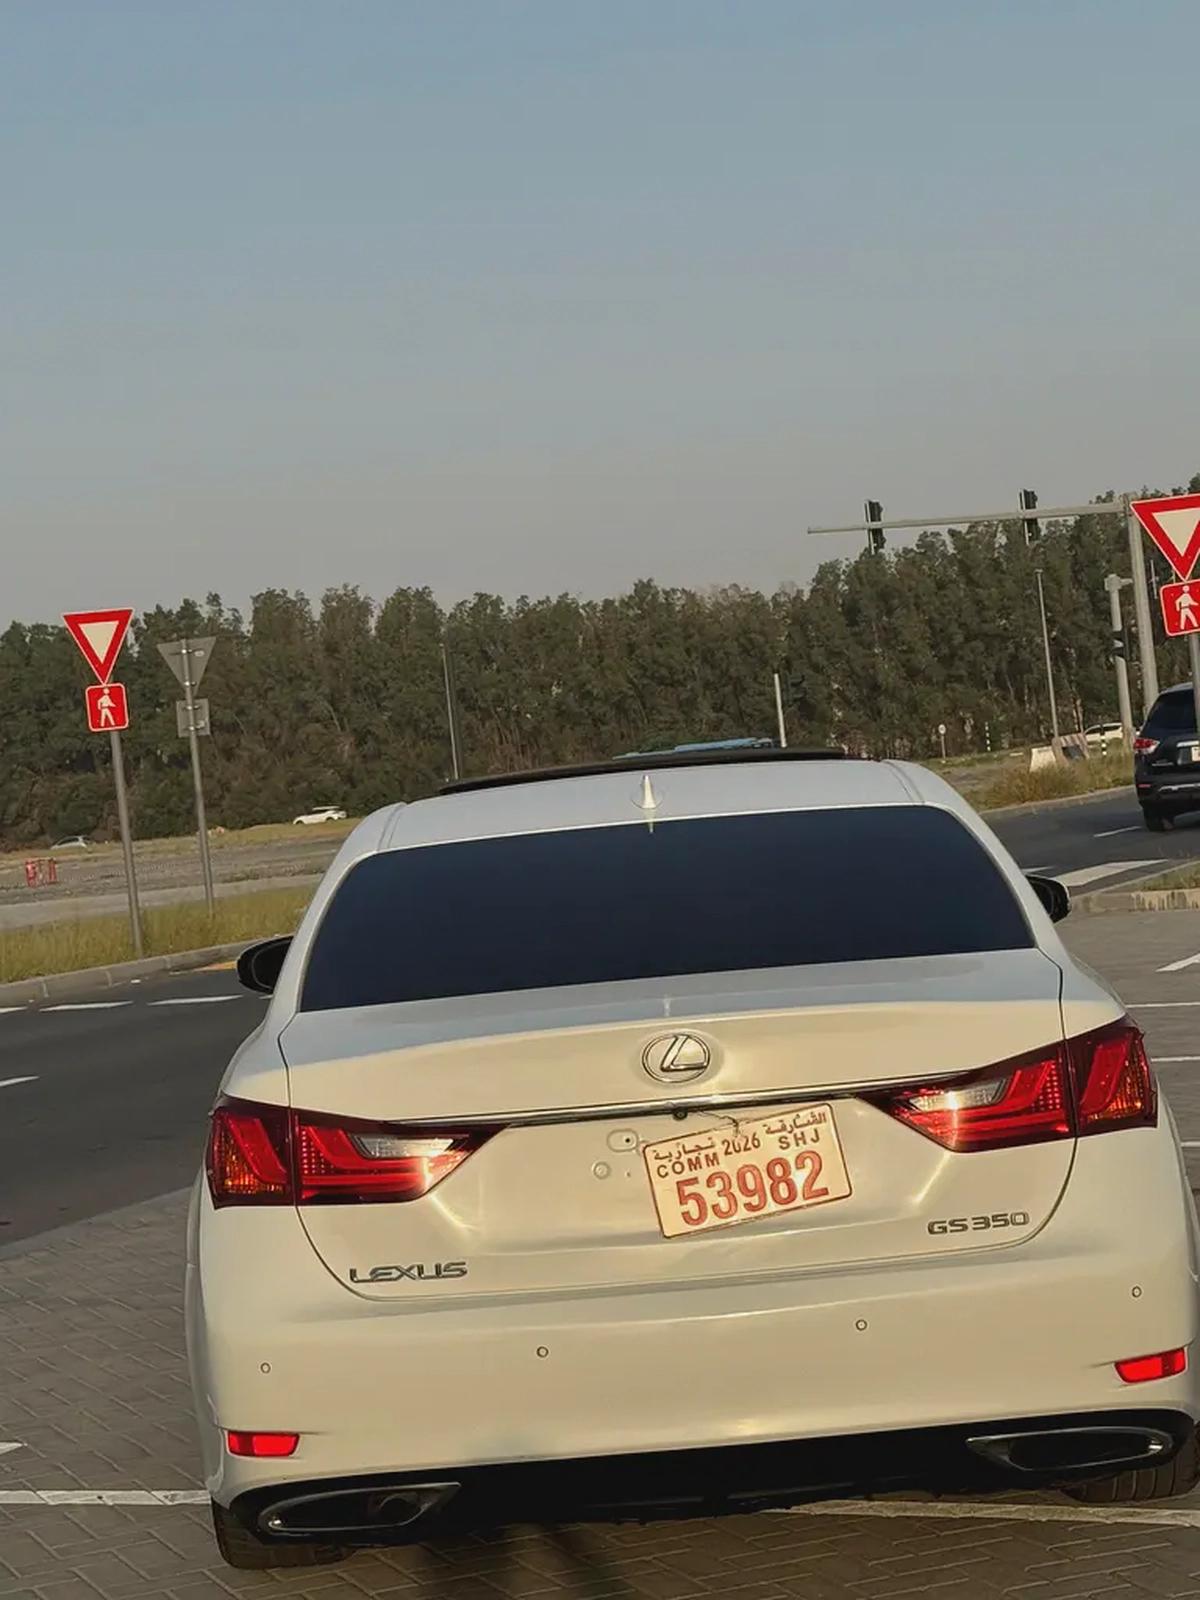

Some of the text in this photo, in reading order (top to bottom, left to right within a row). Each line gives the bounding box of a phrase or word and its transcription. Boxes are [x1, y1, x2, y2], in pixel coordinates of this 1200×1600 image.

[763, 1112, 828, 1135] الشارقة
[653, 1138, 716, 1161] تجارية
[722, 1133, 761, 1156] 2026
[778, 1130, 820, 1151] SHJ
[657, 1153, 720, 1178] COMM
[676, 1150, 829, 1226] 53982
[350, 1262, 467, 1283] LEXUS
